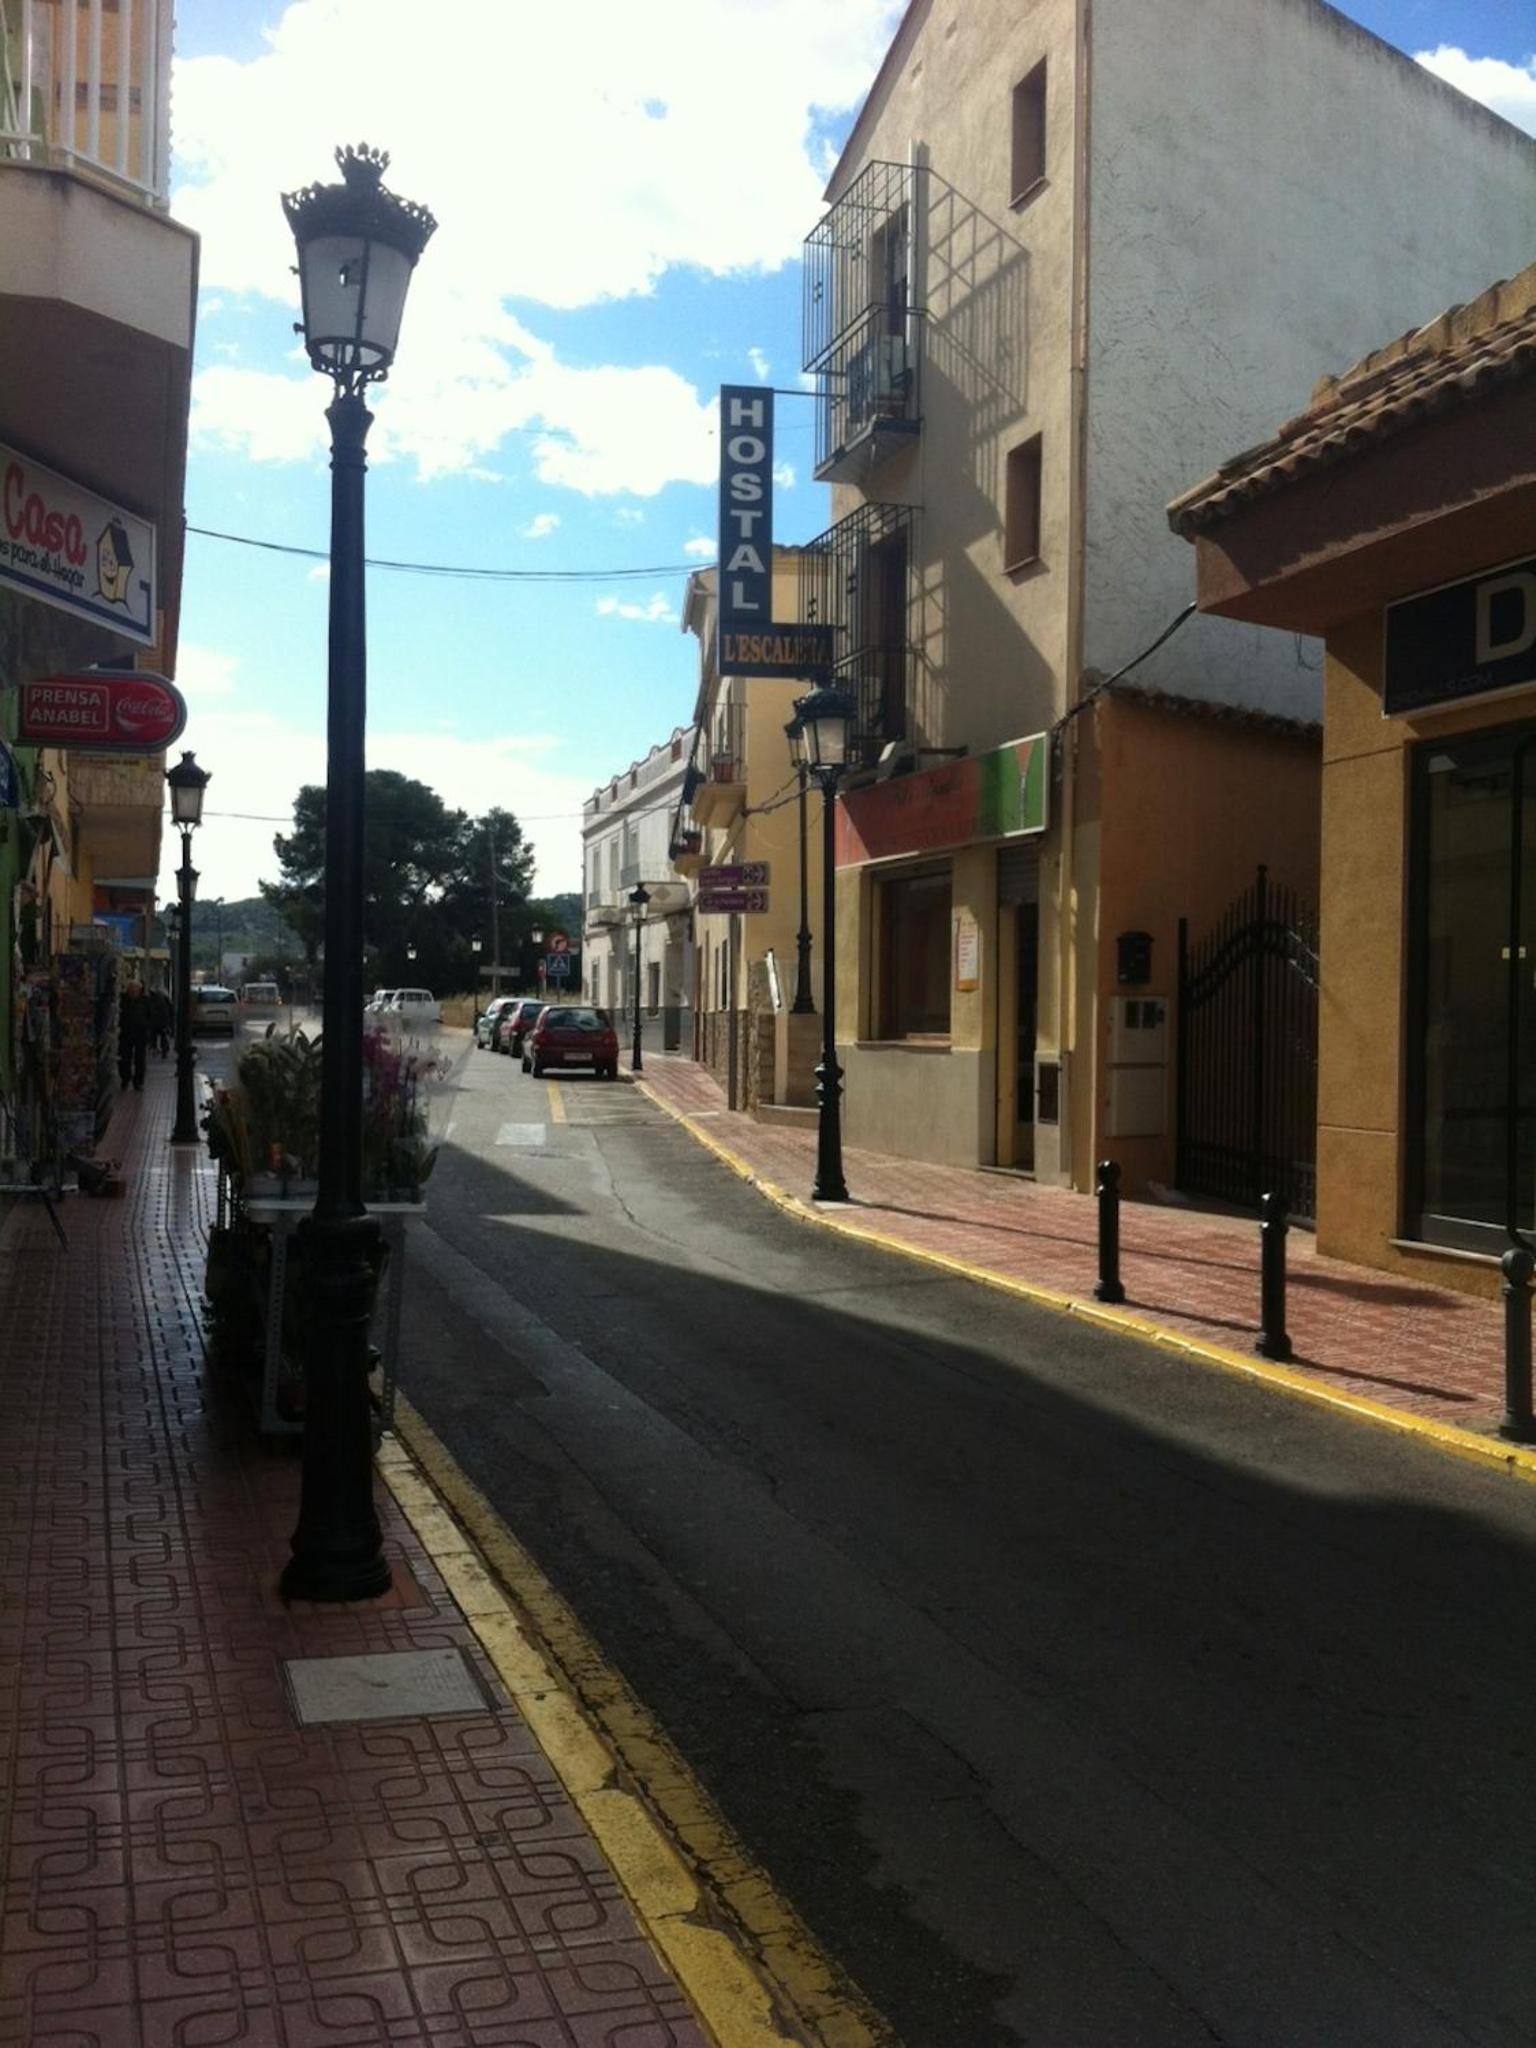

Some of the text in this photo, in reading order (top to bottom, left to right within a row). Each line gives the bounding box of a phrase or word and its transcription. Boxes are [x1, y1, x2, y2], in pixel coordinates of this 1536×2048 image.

[2, 460, 88, 568] Casa
[725, 397, 767, 612] HOSTAL
[30, 706, 103, 726] ANABEL
[31, 688, 102, 706] PRENSA
